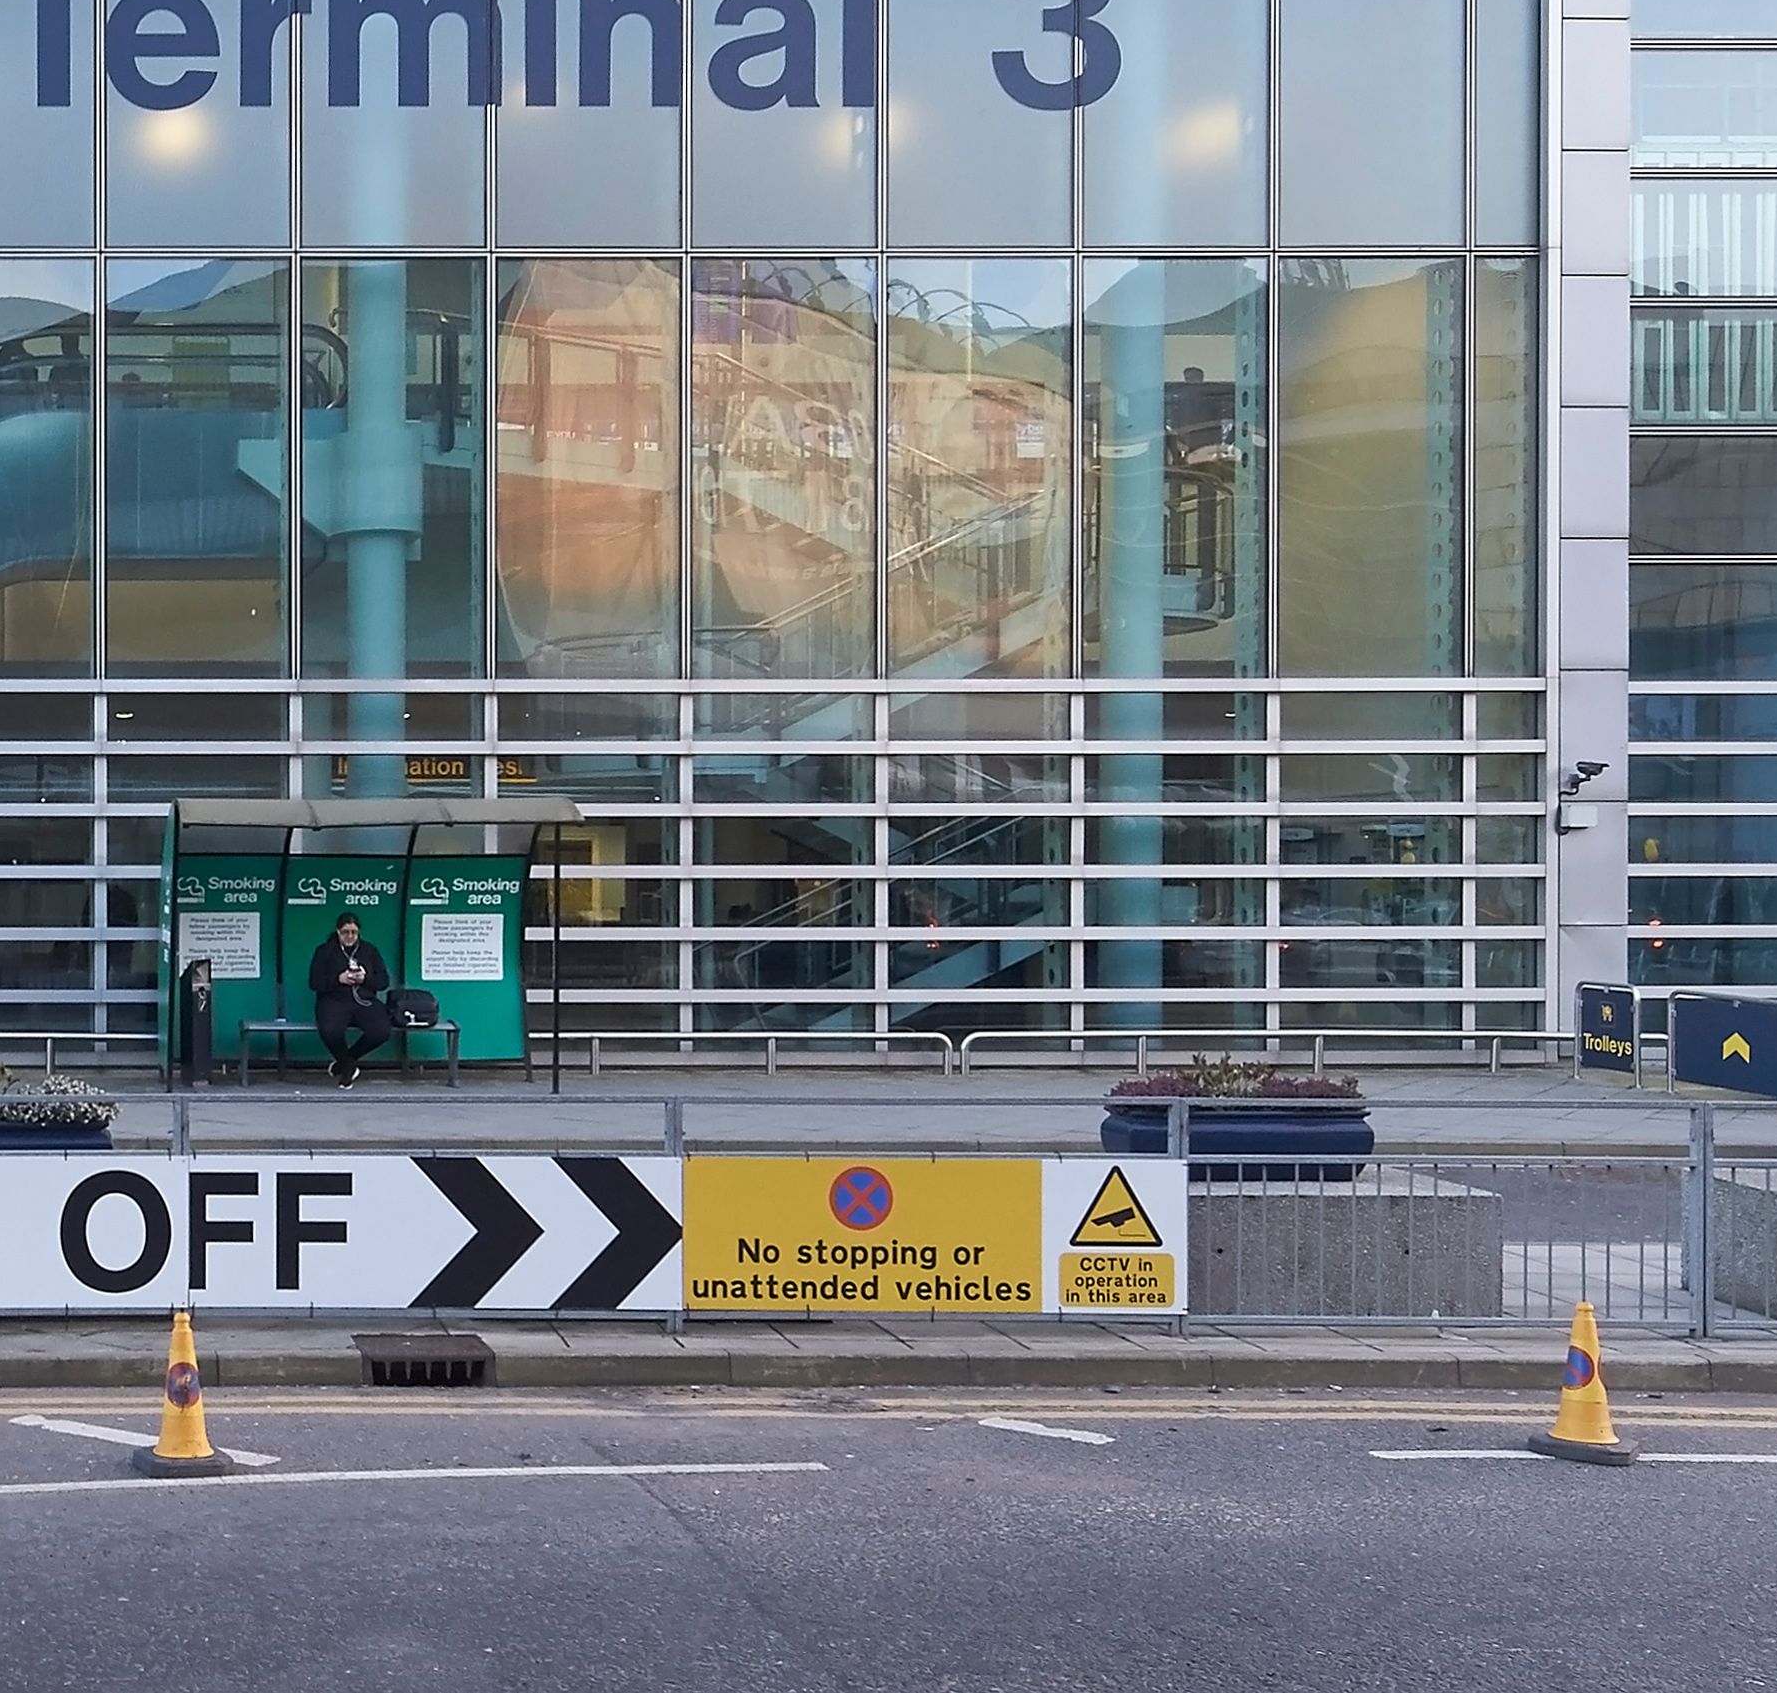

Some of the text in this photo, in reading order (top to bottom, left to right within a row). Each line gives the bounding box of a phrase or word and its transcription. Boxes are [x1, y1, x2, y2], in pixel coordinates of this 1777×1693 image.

[338, 757, 464, 776] Iation
[208, 876, 276, 892] Smoking
[329, 877, 397, 894] Smoking
[452, 877, 520, 894] Smoking
[222, 891, 258, 904] area
[345, 893, 380, 906] area
[467, 893, 501, 905] area
[1583, 1032, 1633, 1057] Trolleys
[59, 1169, 354, 1294] OFF
[737, 1237, 985, 1271] No stopping or
[1079, 1256, 1153, 1273] CCTV in
[691, 1275, 1032, 1302] unattended vehicles
[1073, 1272, 1159, 1291] operation
[1065, 1288, 1167, 1304] in this area
